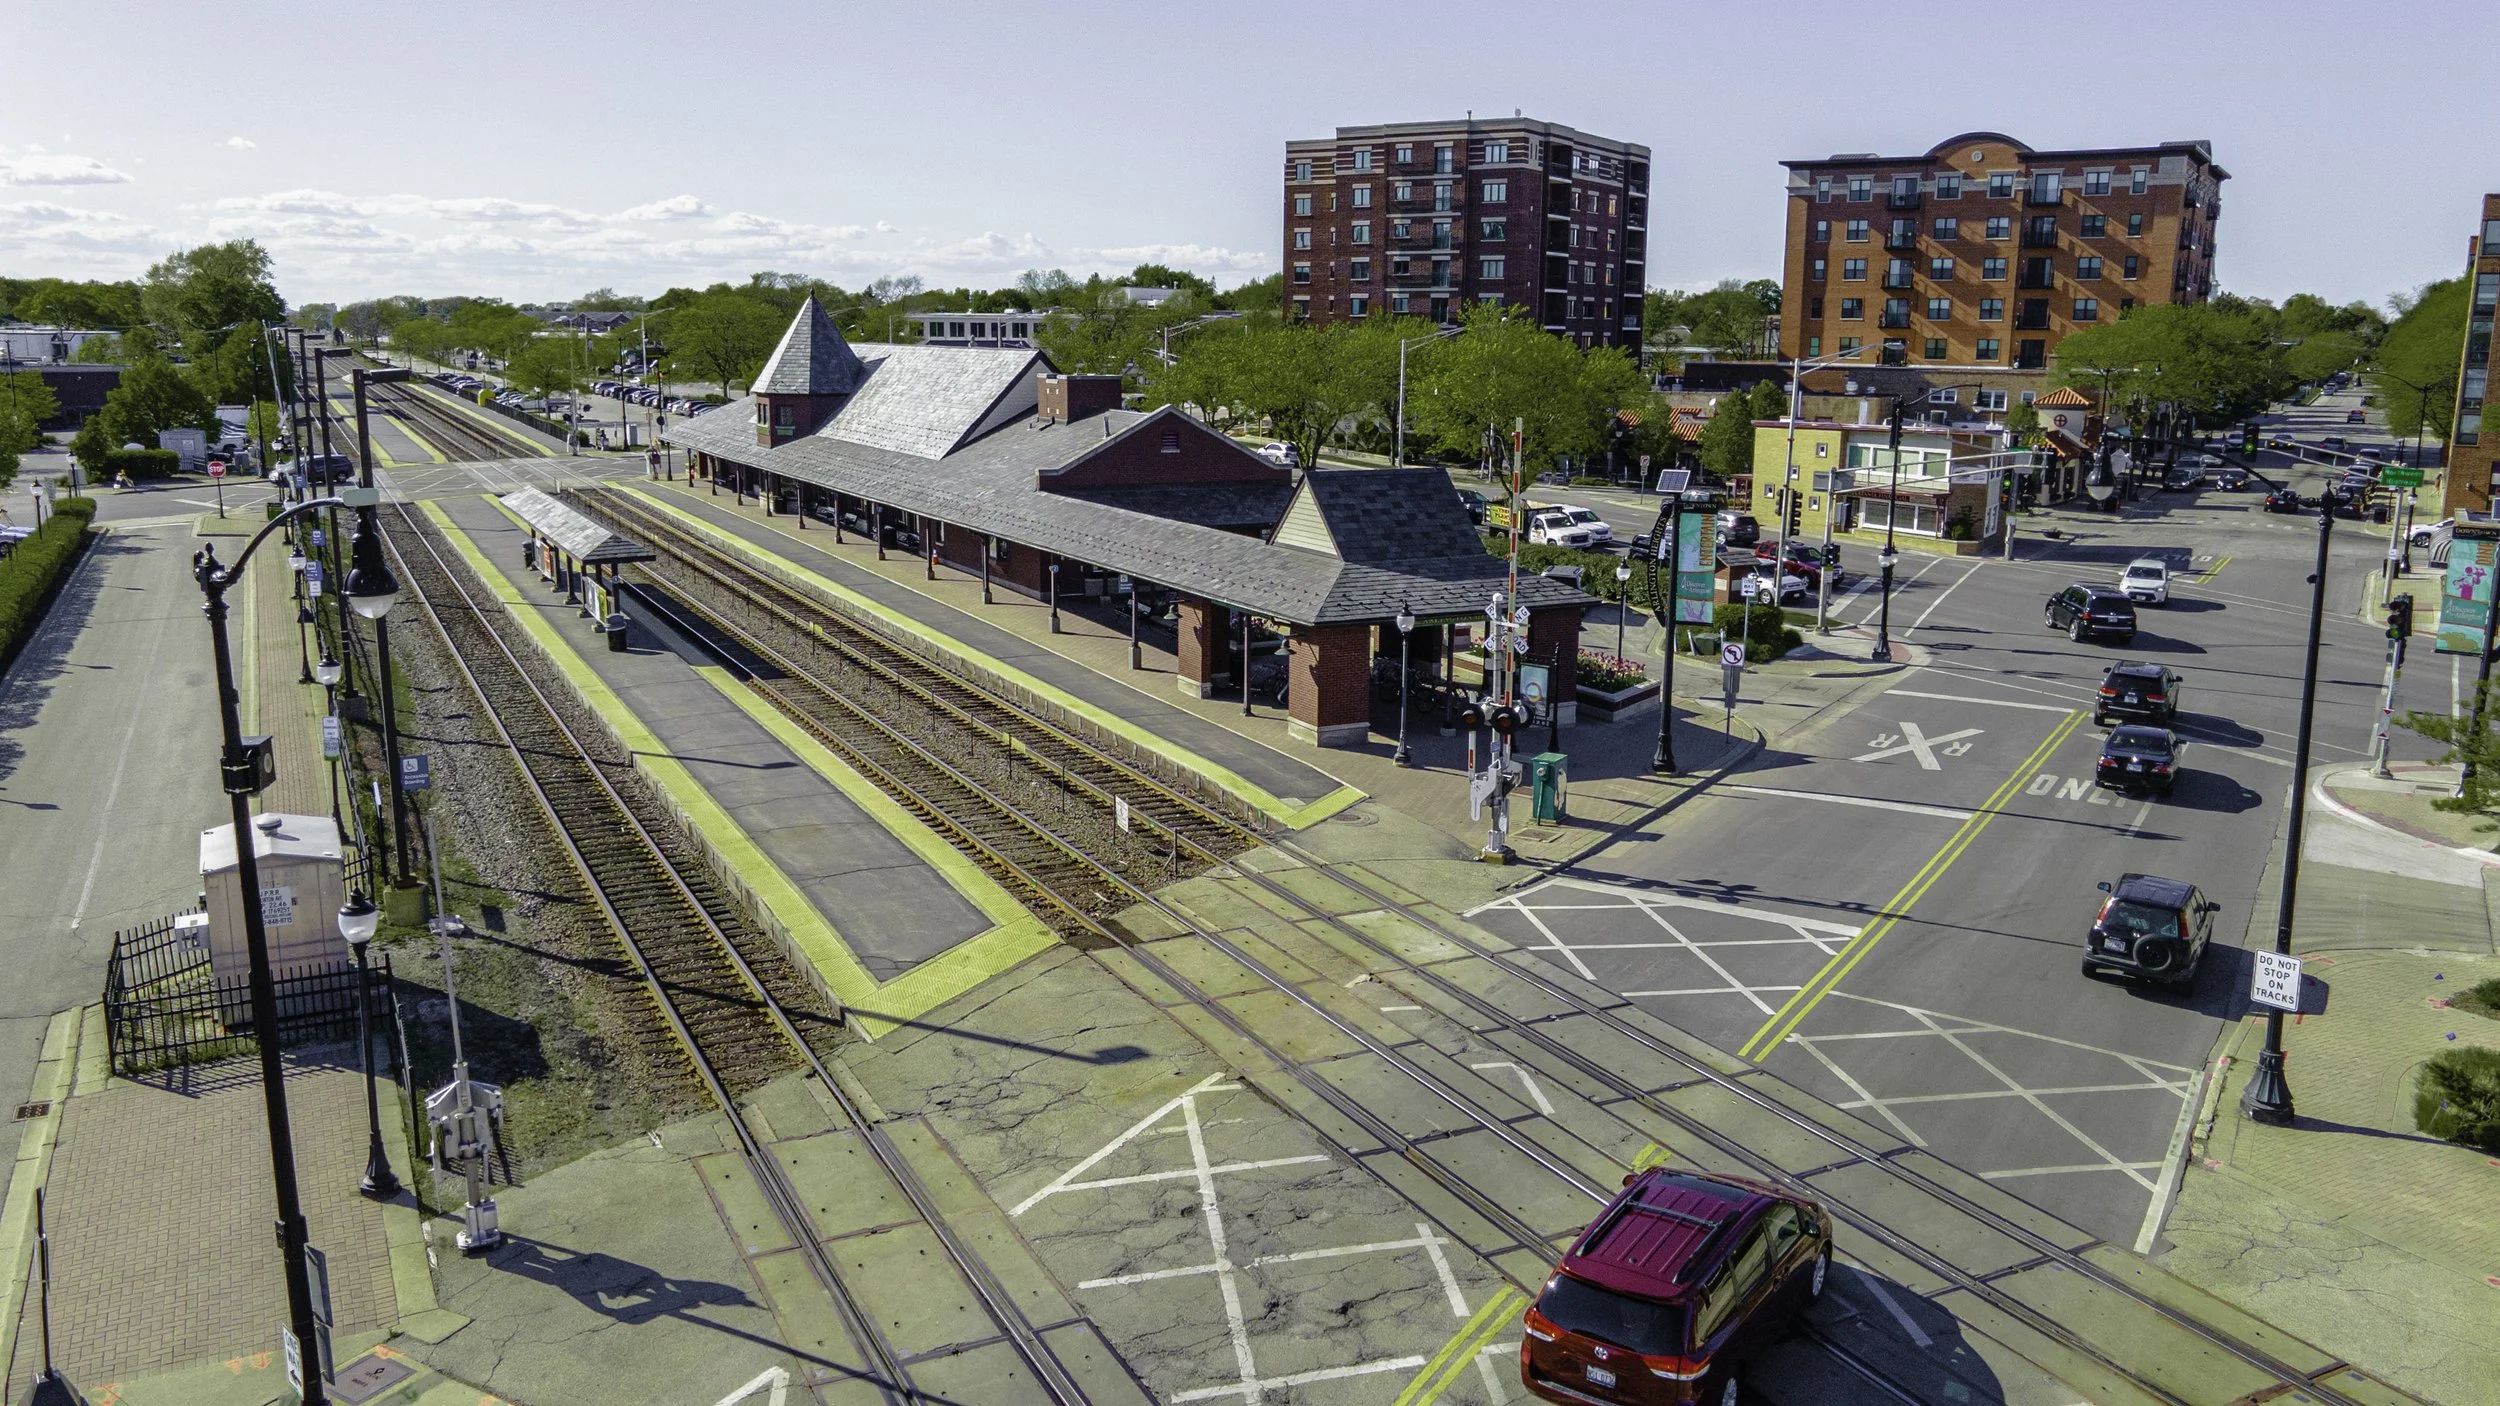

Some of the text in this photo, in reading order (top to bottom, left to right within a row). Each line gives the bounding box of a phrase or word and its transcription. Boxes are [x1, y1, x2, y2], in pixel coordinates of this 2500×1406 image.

[209, 465, 224, 473] STOP
[2455, 527, 2497, 536] DOWNTOWN
[1648, 516, 1666, 612] ARLINGTON HEIGHTS
[2259, 955, 2297, 971] DO NOT
[2263, 967, 2290, 980] STOP
[2268, 980, 2283, 991] ON
[2256, 986, 2294, 1005] TRACKS
[285, 1331, 299, 1352] ONE
[287, 1350, 301, 1371] WAY
